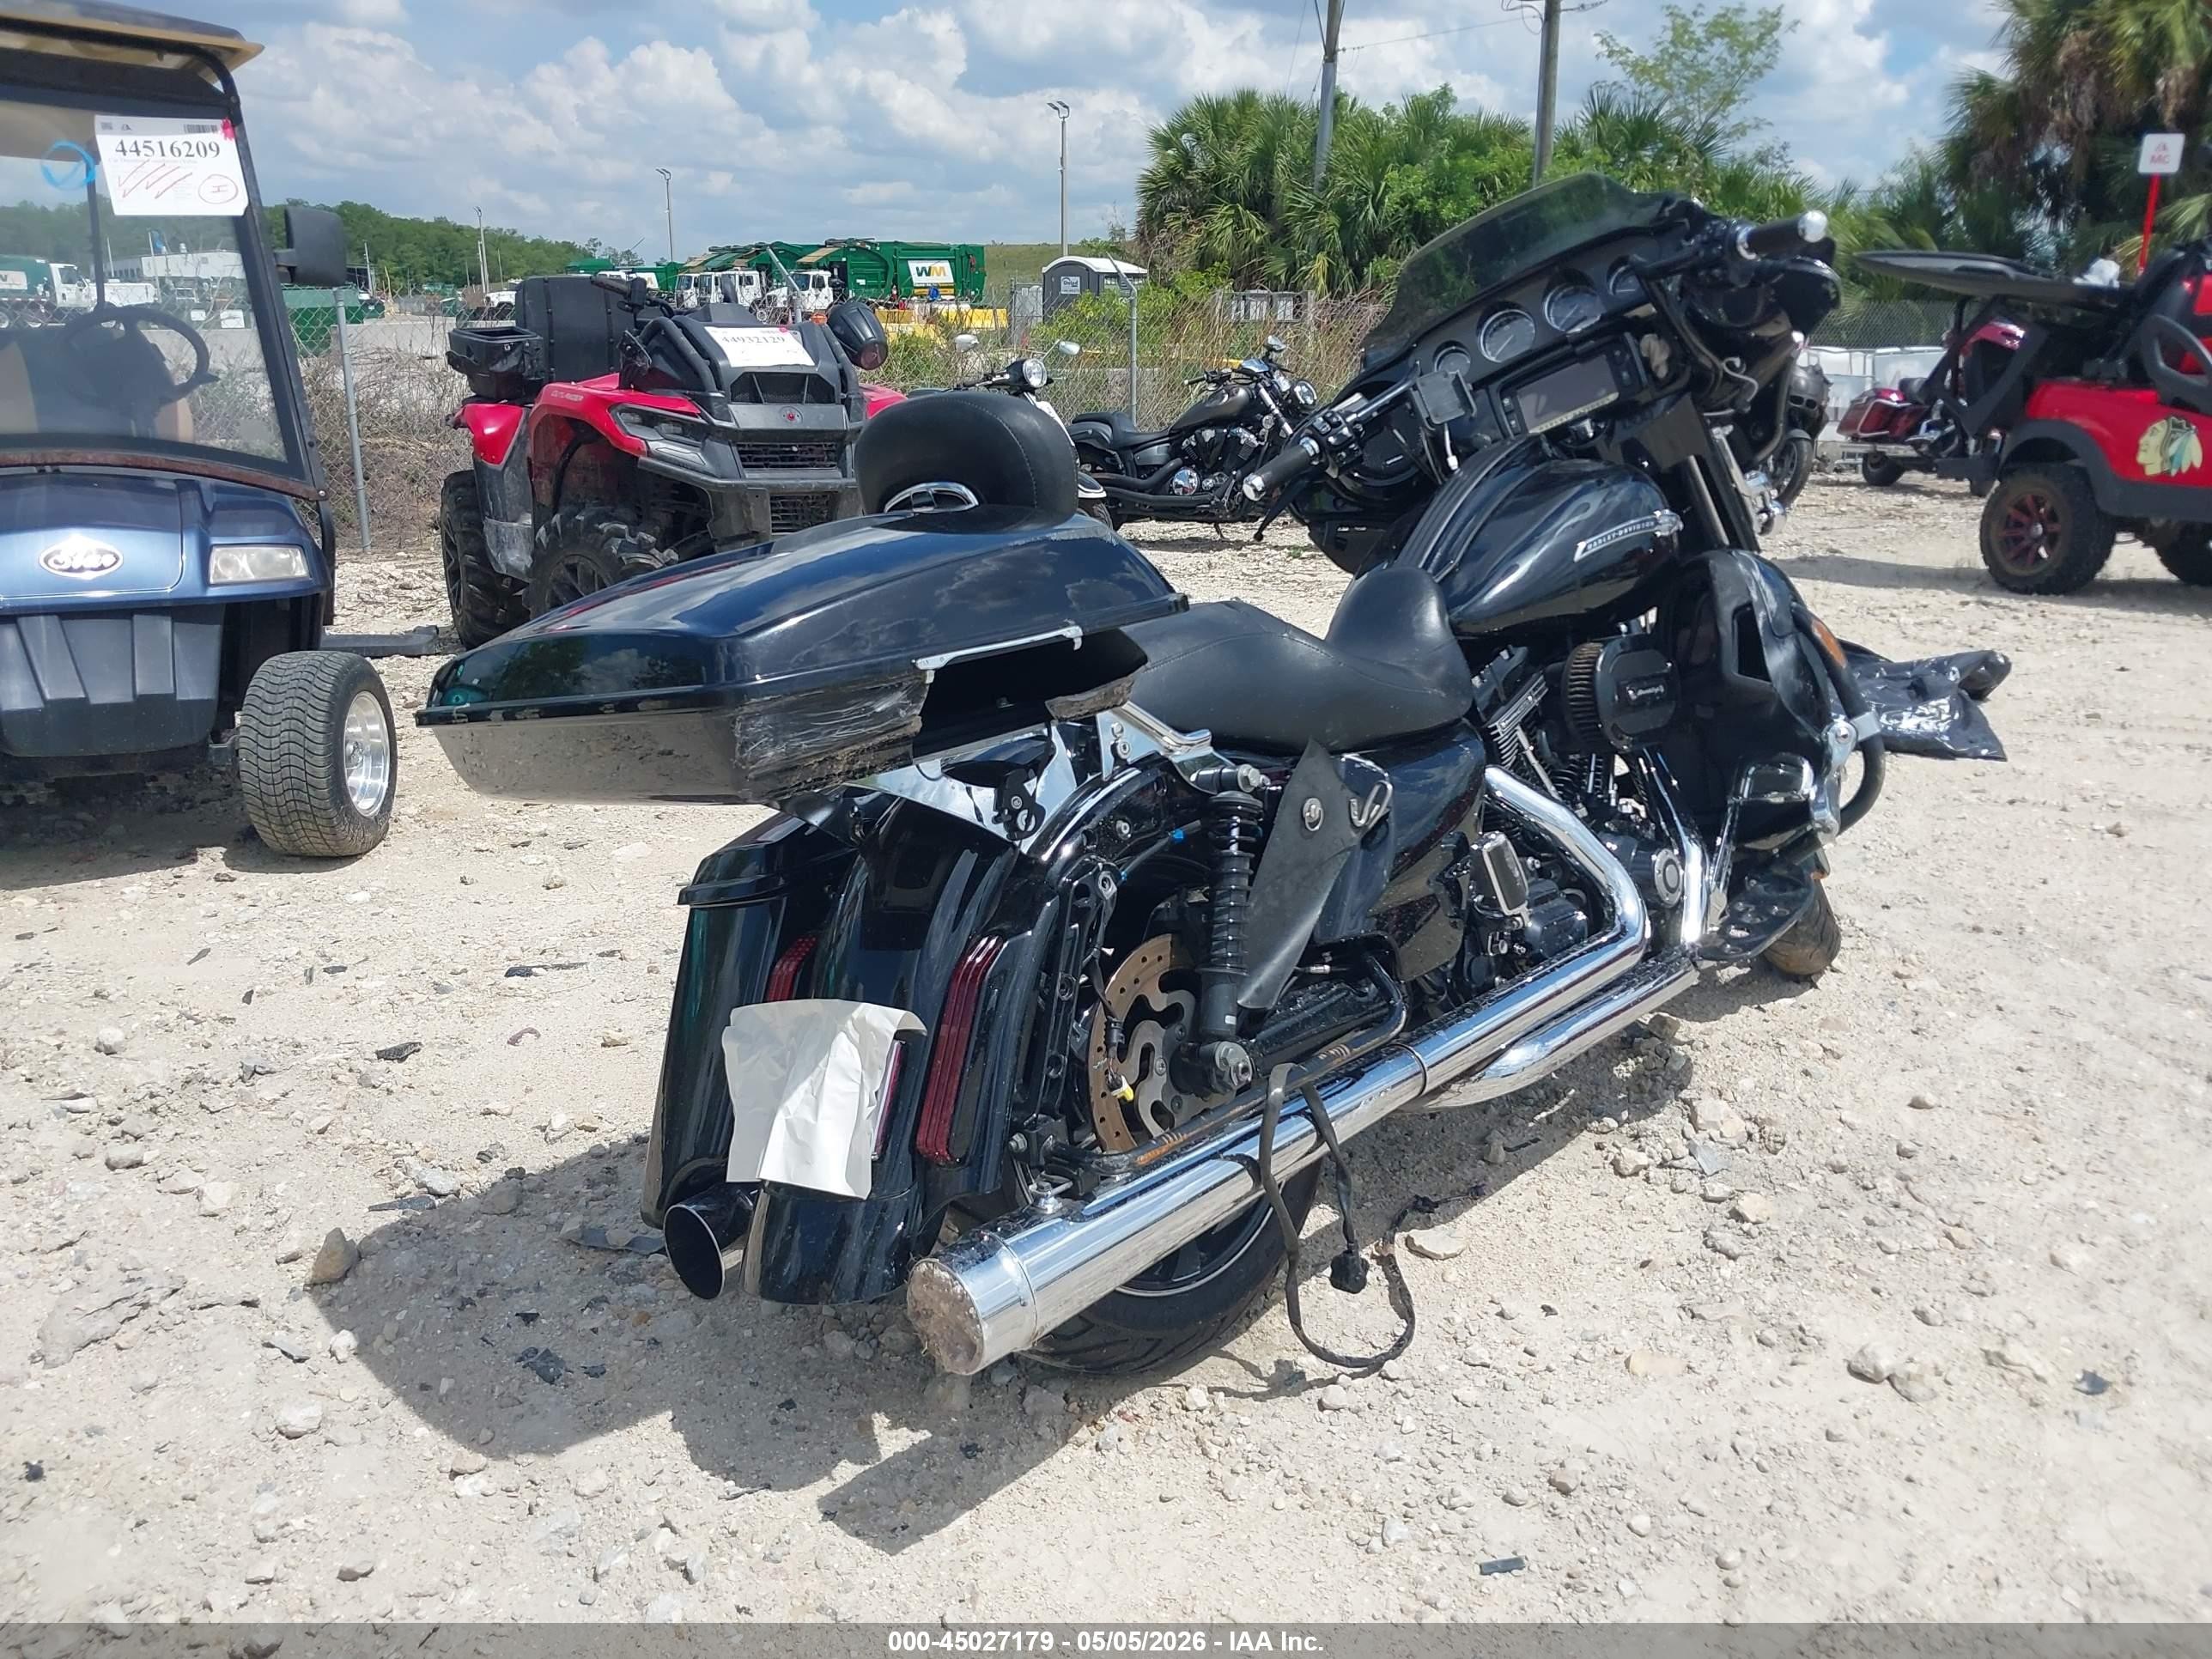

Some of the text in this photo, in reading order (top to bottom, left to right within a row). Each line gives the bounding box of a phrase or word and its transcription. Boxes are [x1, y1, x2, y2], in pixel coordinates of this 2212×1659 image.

[115, 138, 221, 158] 44516209
[915, 265, 947, 277] WM
[721, 335, 786, 344] 44932129
